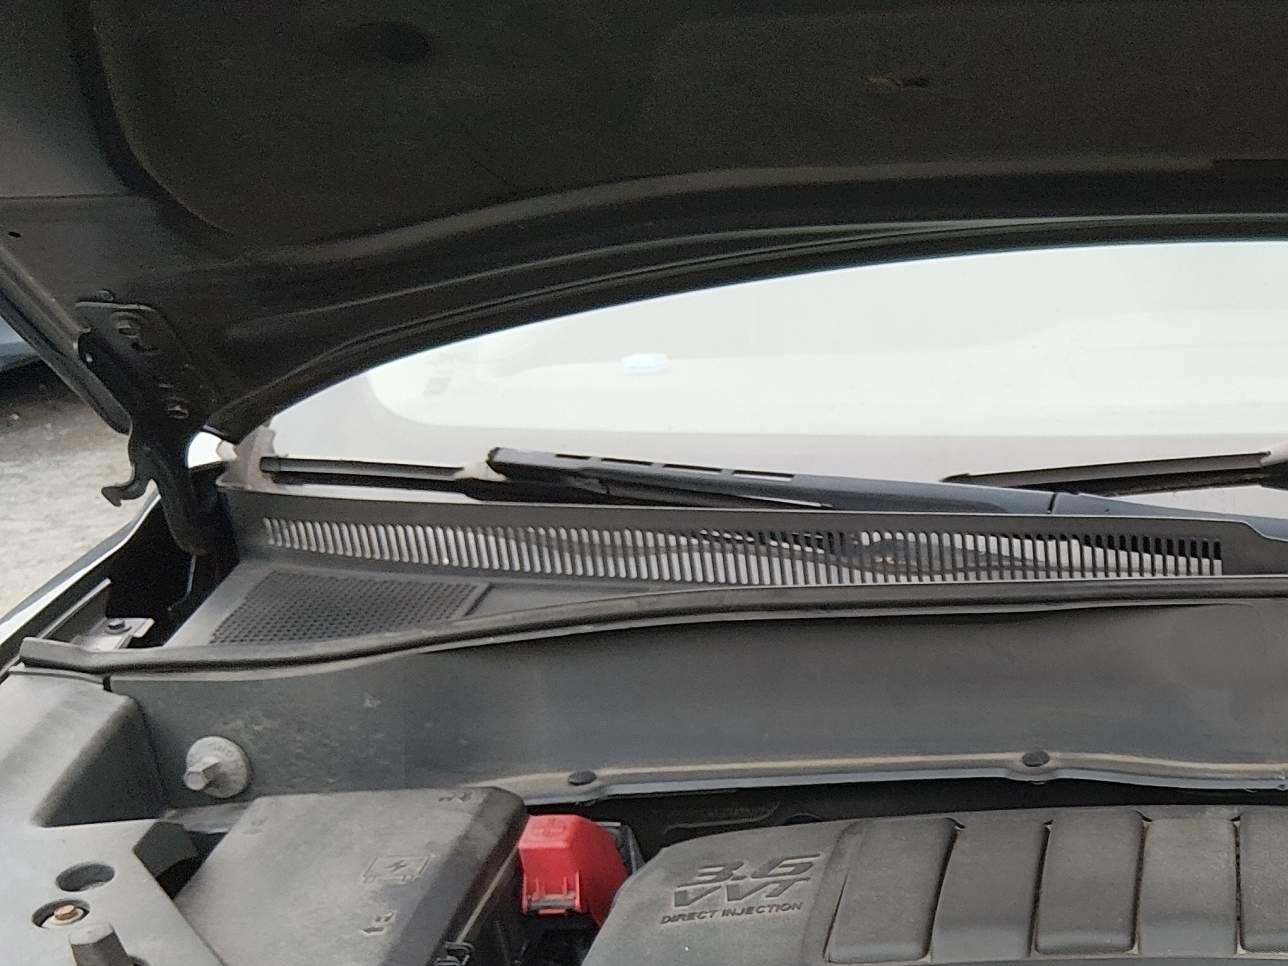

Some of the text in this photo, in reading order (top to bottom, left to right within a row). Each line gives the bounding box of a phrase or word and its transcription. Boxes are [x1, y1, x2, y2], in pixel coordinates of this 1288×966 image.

[676, 853, 822, 888] 3.6
[673, 877, 812, 908] VVT
[660, 903, 803, 925] DIRECT INJECTION
